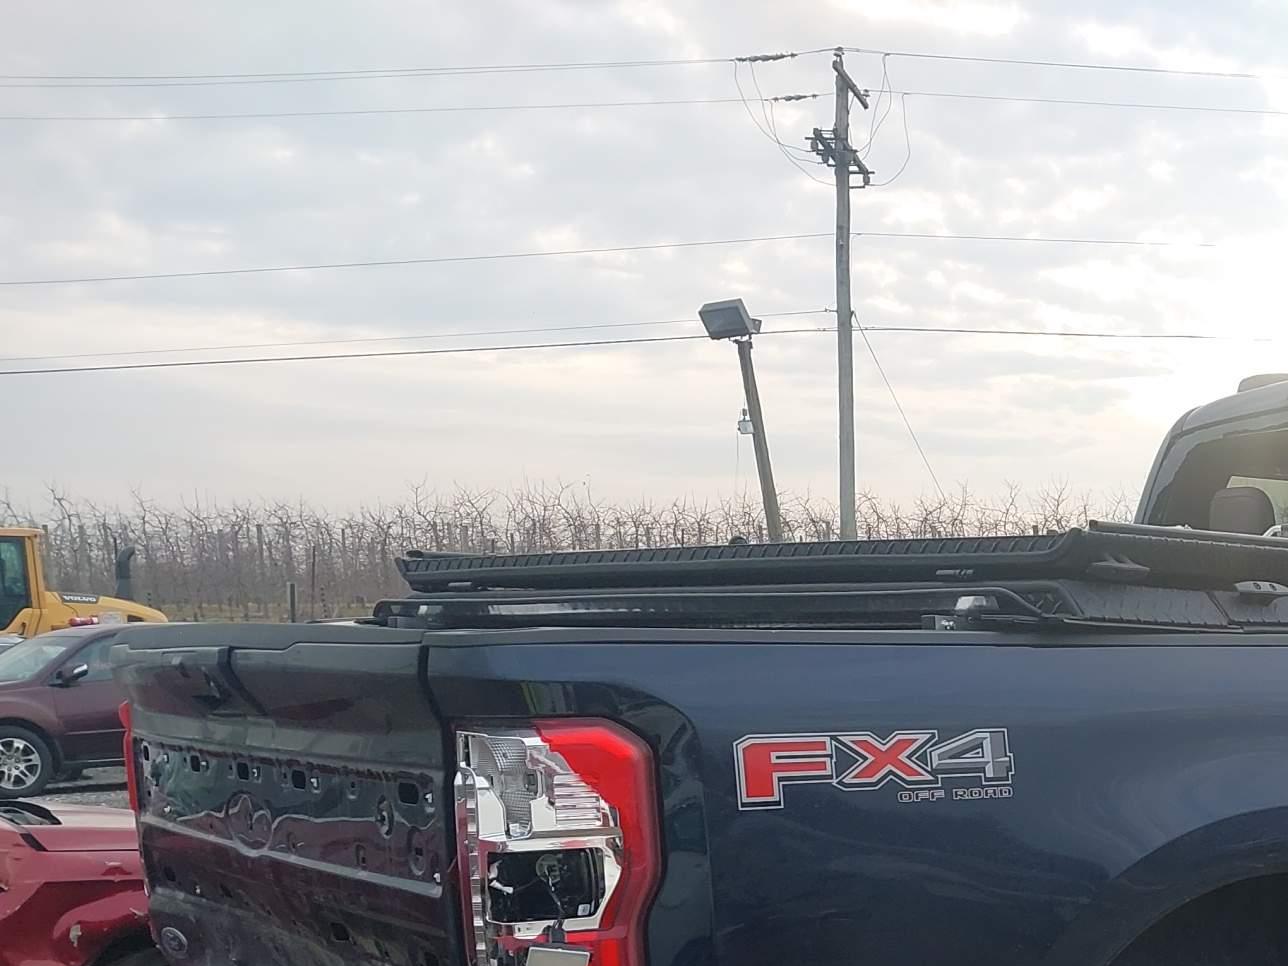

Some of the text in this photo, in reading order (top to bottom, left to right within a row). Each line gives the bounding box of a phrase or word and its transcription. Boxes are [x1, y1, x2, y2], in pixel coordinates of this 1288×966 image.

[733, 728, 1015, 811] FX4
[897, 786, 1013, 803] OFF ROAD
